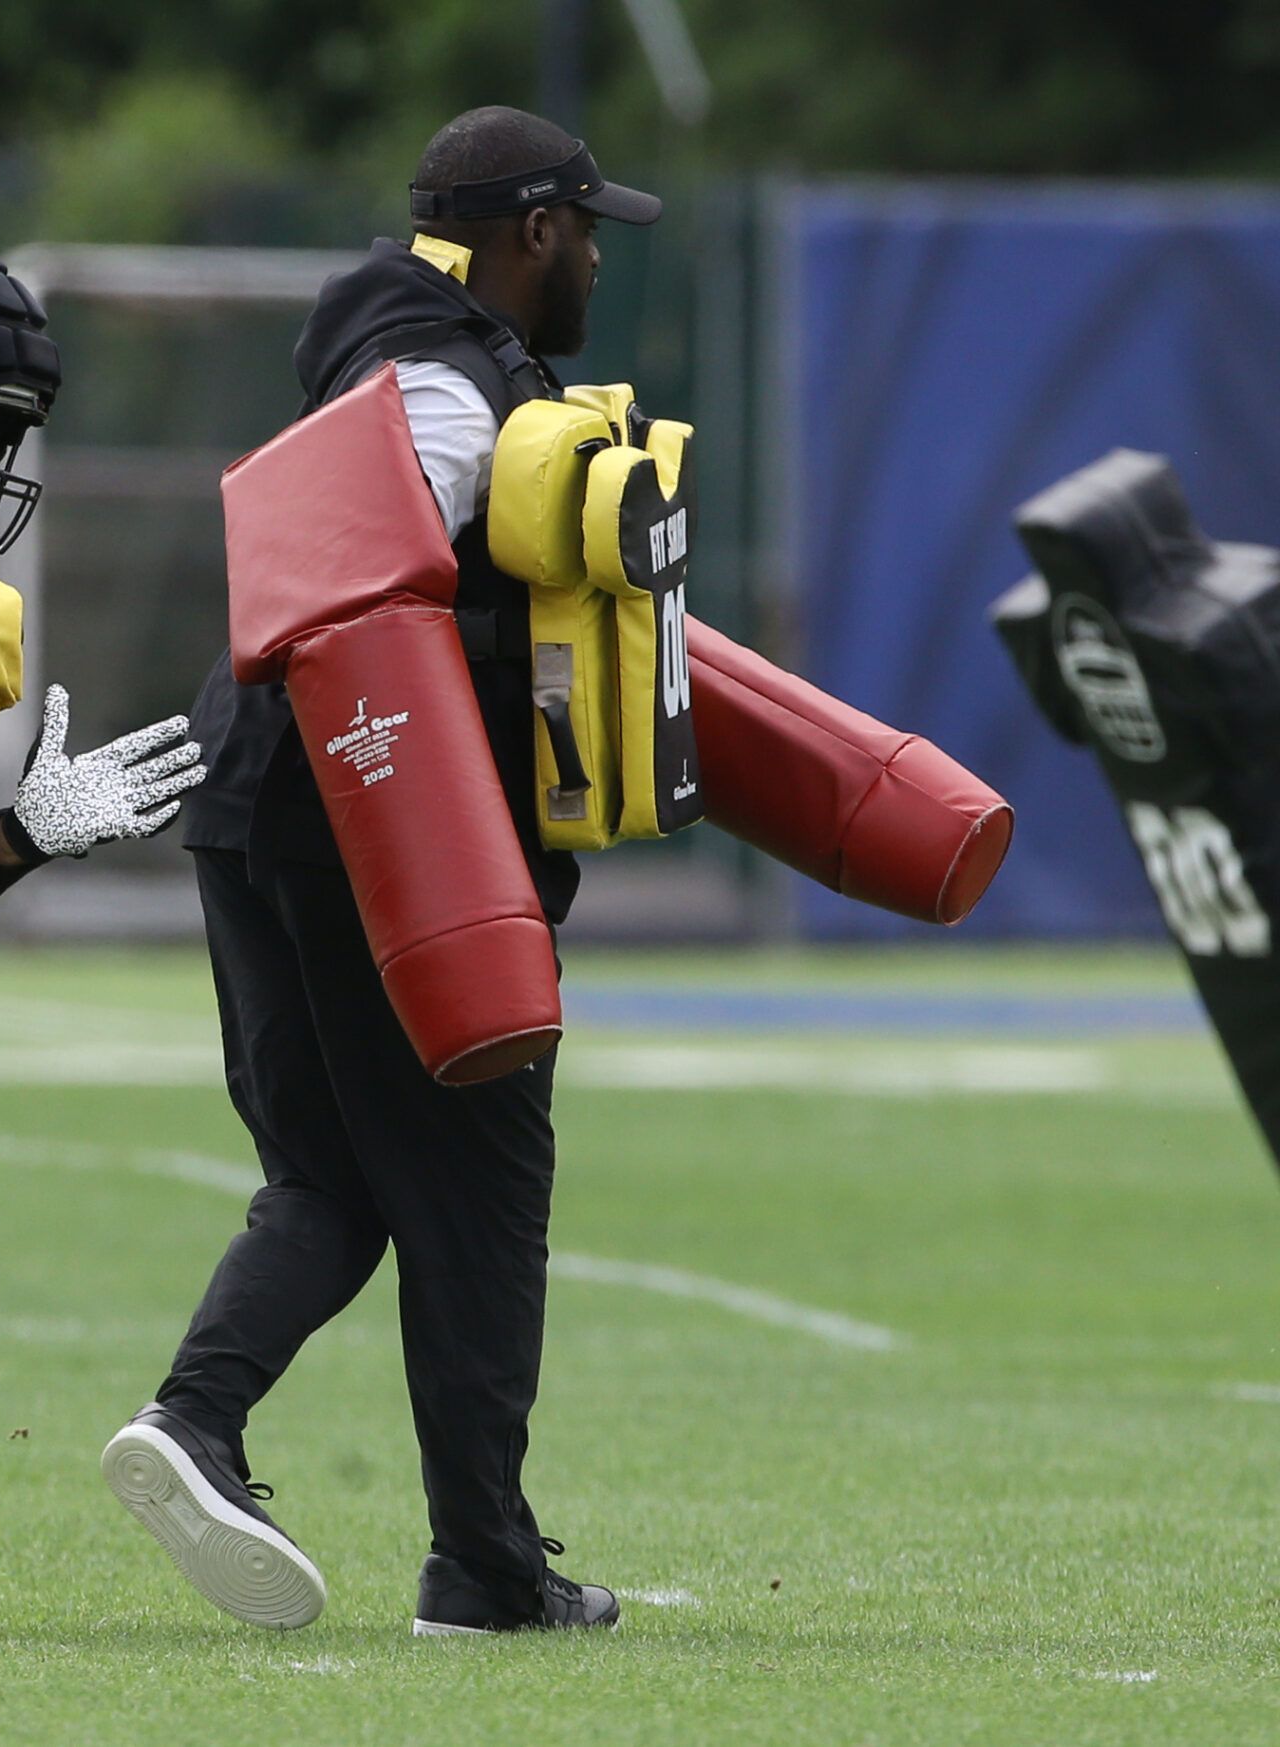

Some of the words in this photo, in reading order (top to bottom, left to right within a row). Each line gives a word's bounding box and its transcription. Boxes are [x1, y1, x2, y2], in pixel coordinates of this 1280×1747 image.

[649, 519, 667, 575] FIT
[326, 726, 369, 755] Gilman
[370, 711, 410, 732] Gear
[362, 764, 394, 787] 2020
